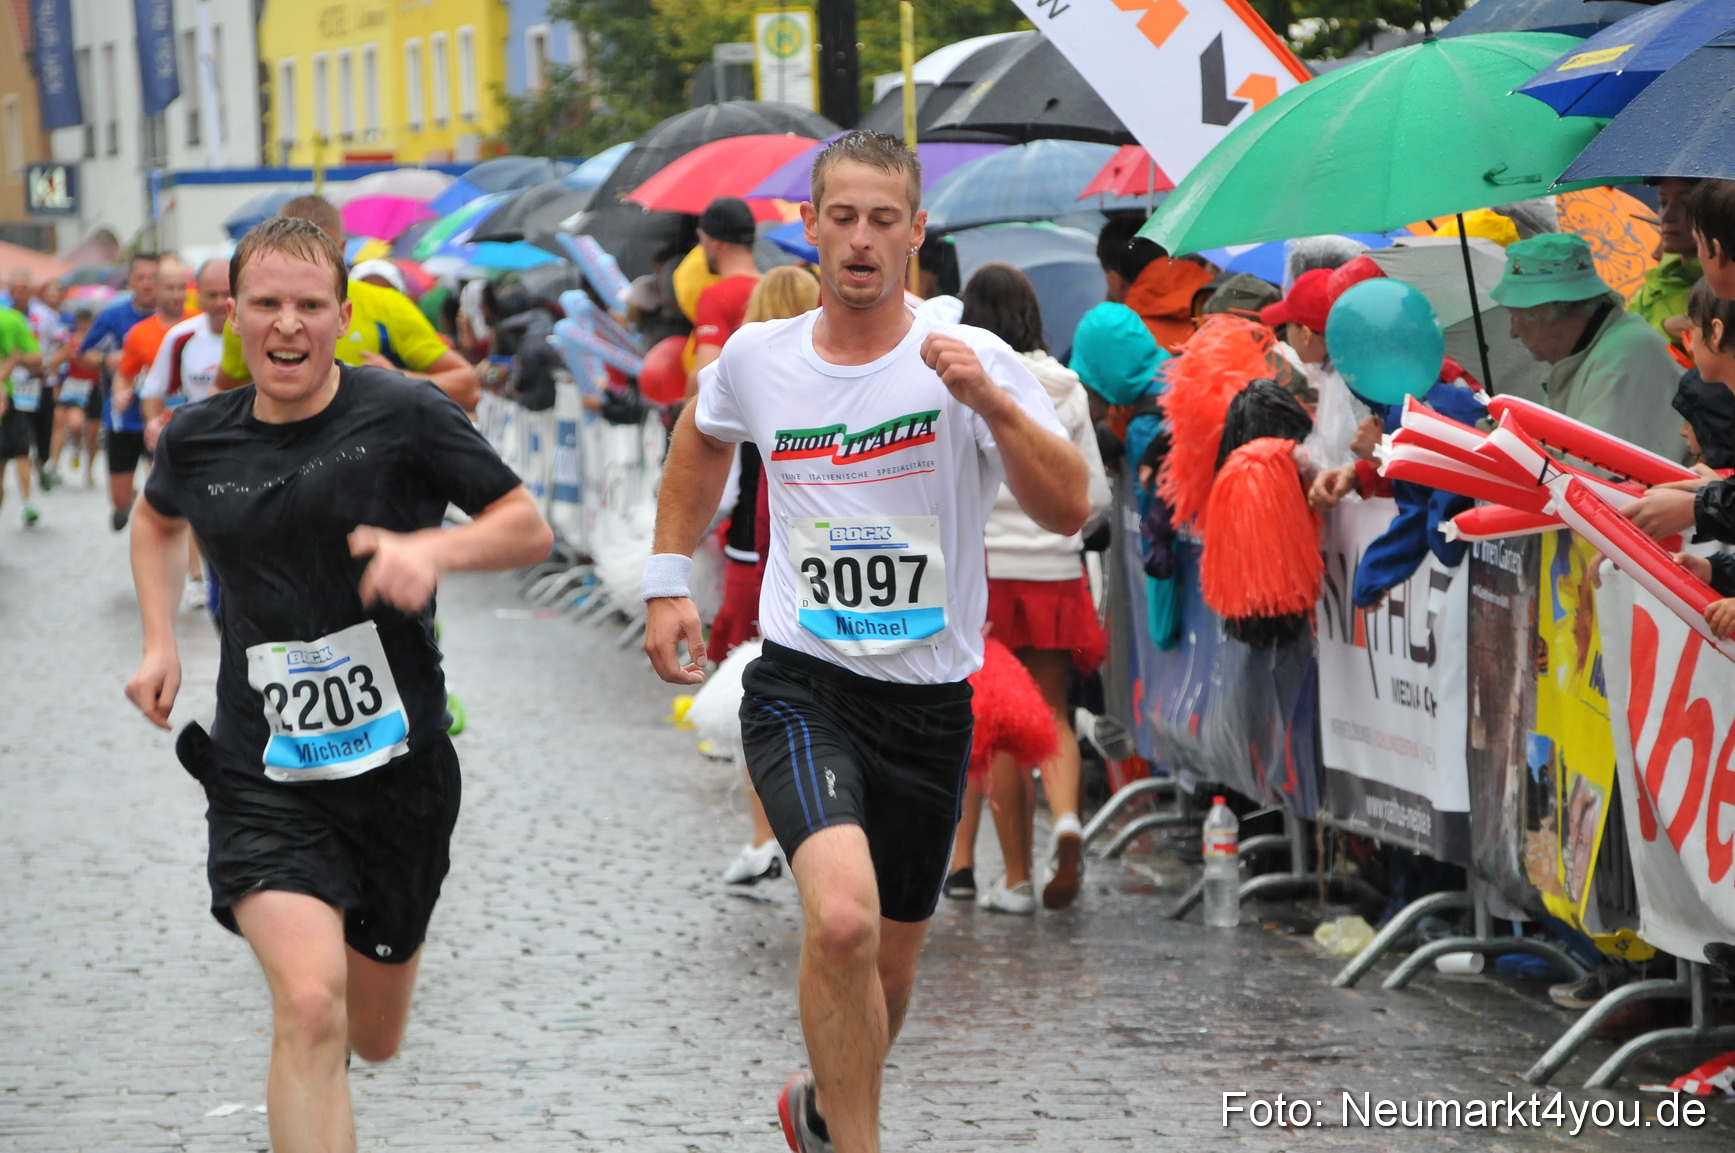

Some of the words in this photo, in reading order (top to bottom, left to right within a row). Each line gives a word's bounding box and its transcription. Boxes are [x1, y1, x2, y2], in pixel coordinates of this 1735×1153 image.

[842, 414, 935, 459] ITALIA
[781, 473, 801, 481] FEINE
[809, 470, 869, 481] ITALIENISCHE
[877, 460, 935, 477] SPEZIALITÄTEN
[829, 526, 893, 542] BOCK
[801, 555, 929, 608] 3097
[835, 615, 910, 636] Michael
[263, 664, 383, 732] 2203
[295, 731, 373, 764] Michael
